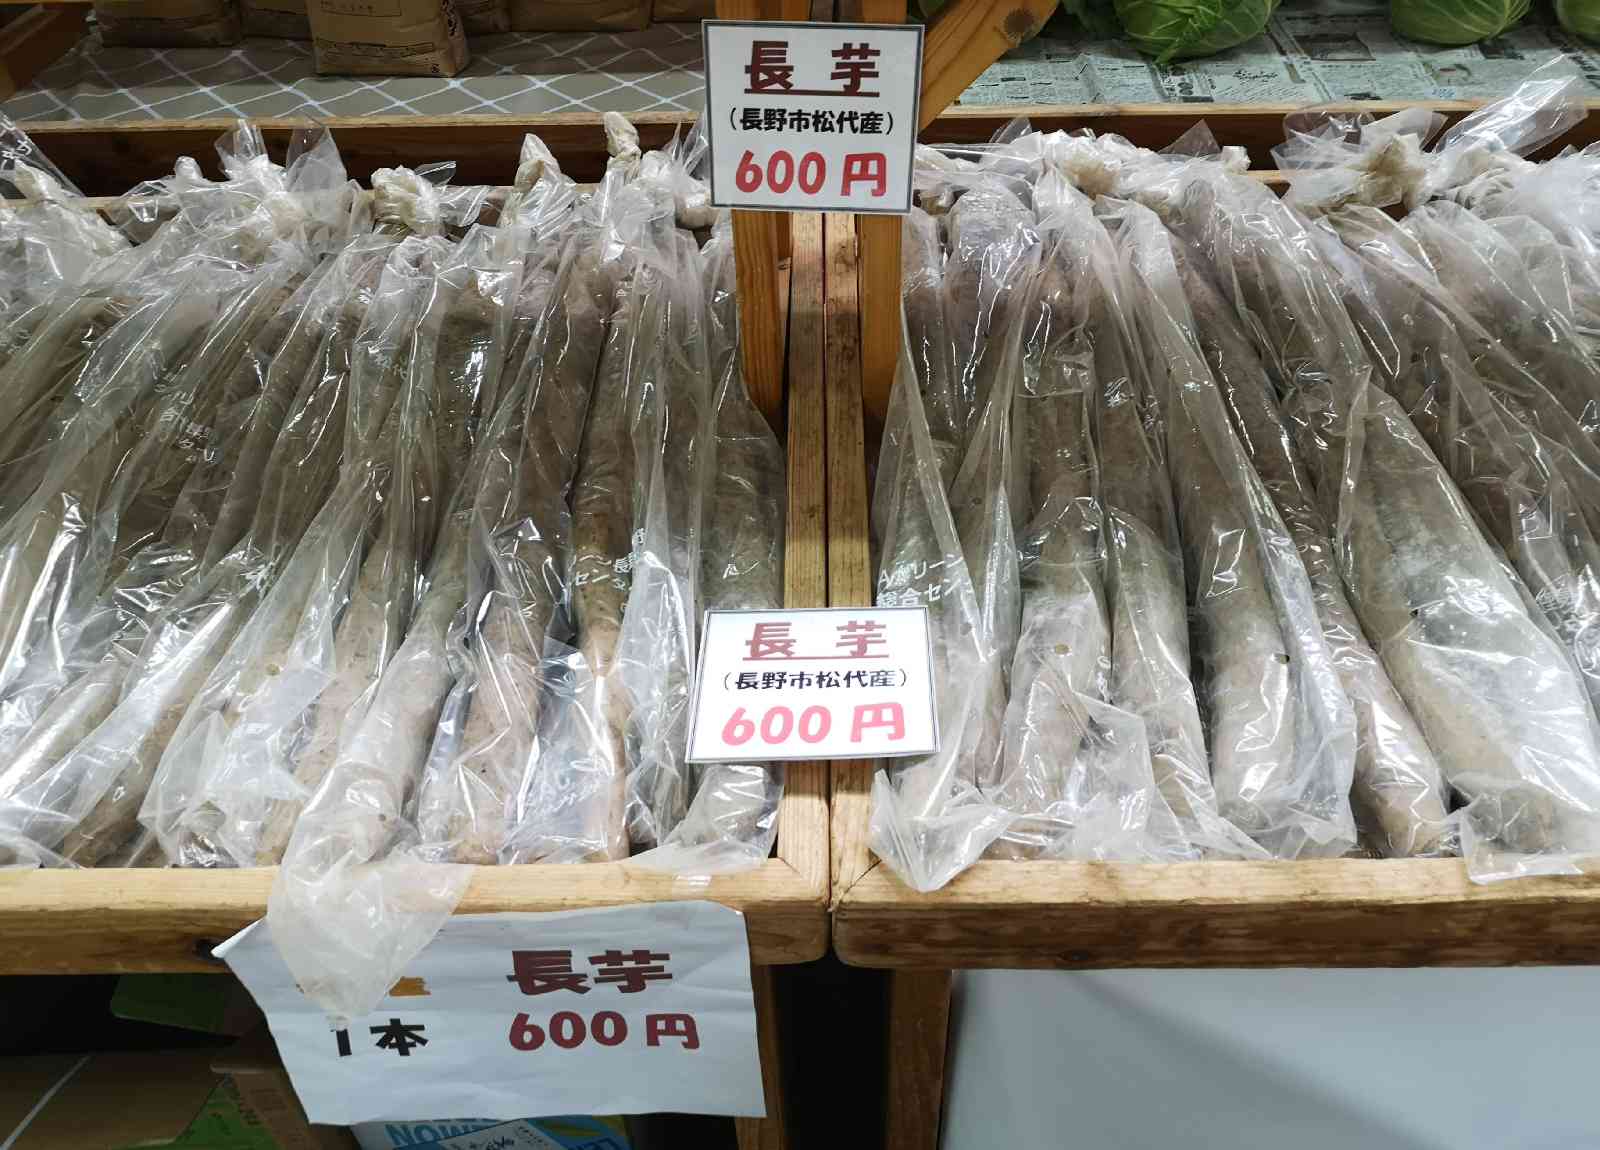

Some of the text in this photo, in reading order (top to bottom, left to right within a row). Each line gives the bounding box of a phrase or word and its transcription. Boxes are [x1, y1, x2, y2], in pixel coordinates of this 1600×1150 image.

[744, 40, 881, 93] 長芋
[729, 107, 894, 135] （長野市松代産）
[735, 150, 887, 197] 600円
[744, 620, 888, 659] 長芋
[724, 669, 907, 690] （長野市松代産）
[721, 702, 905, 746] 600円
[506, 950, 673, 995] 長芋
[509, 1011, 700, 1051] 600円
